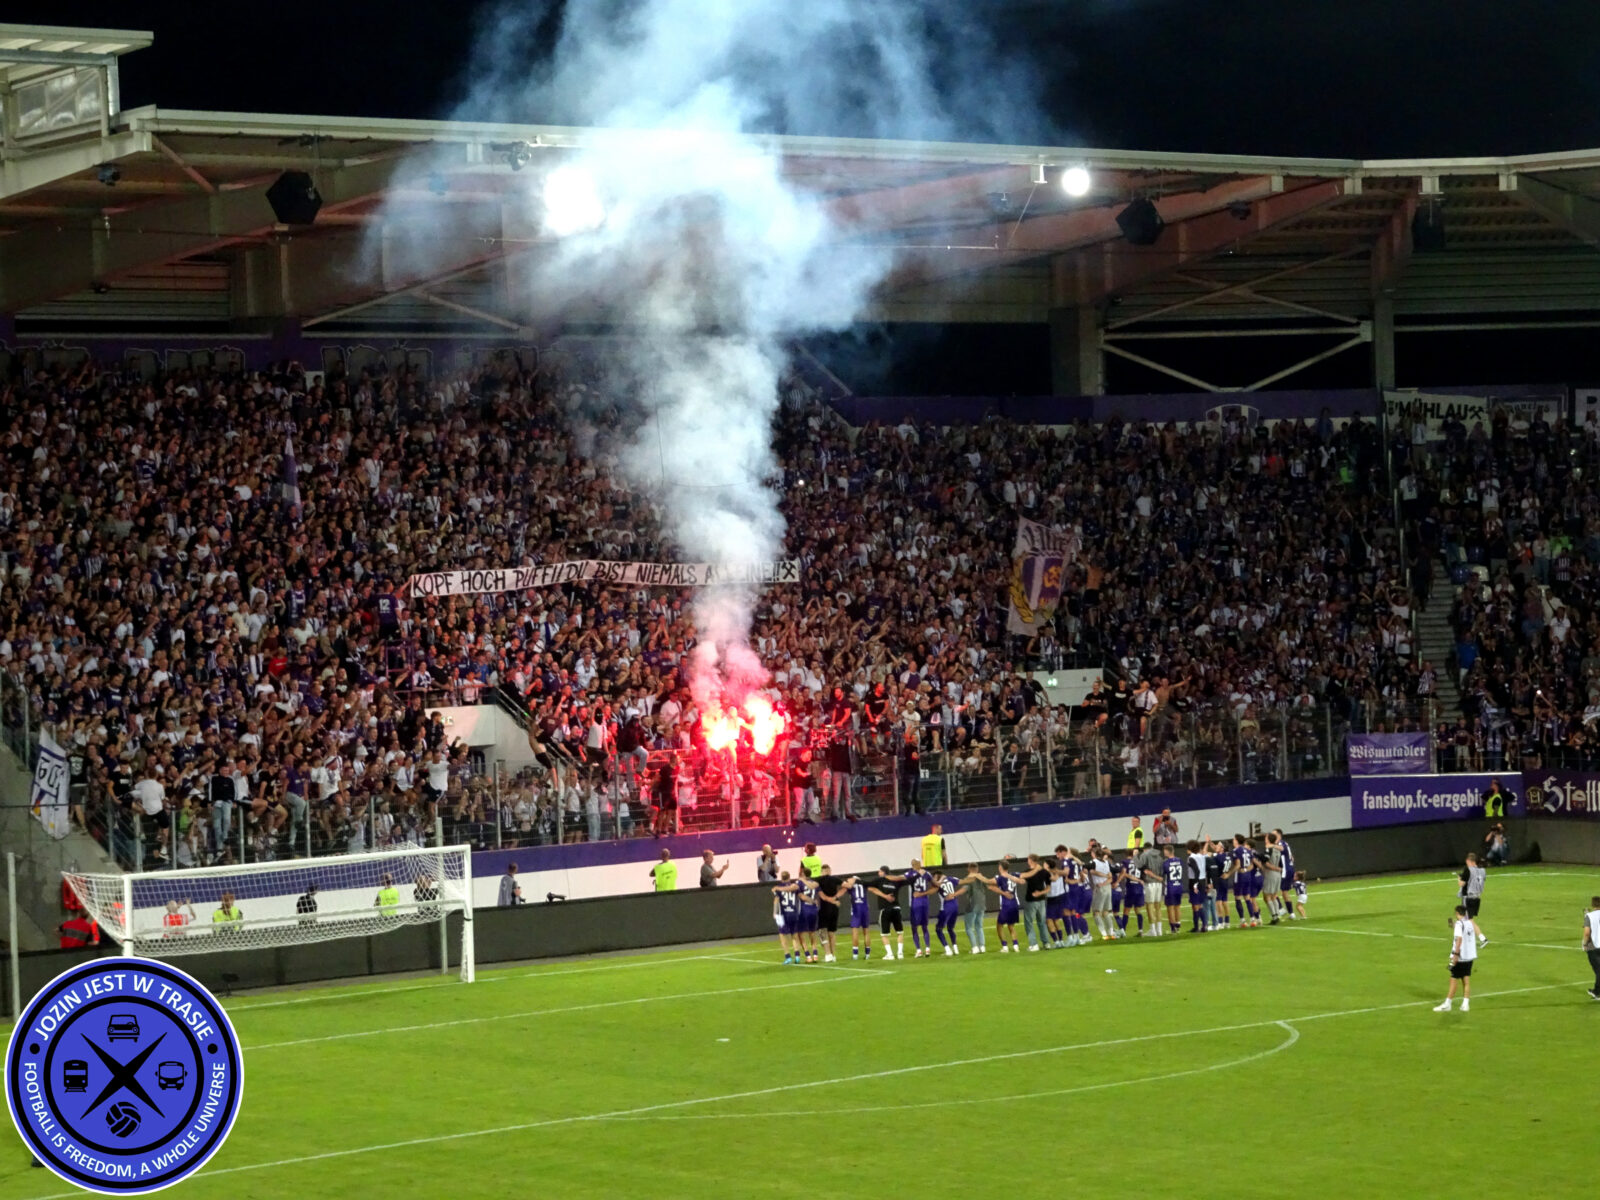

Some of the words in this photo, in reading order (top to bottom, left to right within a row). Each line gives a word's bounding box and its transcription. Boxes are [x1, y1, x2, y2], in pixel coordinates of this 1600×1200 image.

[413, 573, 454, 596] KOPF
[461, 571, 506, 591] HOCH
[594, 562, 632, 581] BIST
[636, 563, 698, 584] NIEMALS
[379, 599, 390, 611] 12
[1350, 744, 1427, 759] Wismutadler
[1169, 865, 1182, 880] 23
[853, 884, 864, 898] 11
[940, 881, 955, 896] 30
[781, 890, 796, 905] 34
